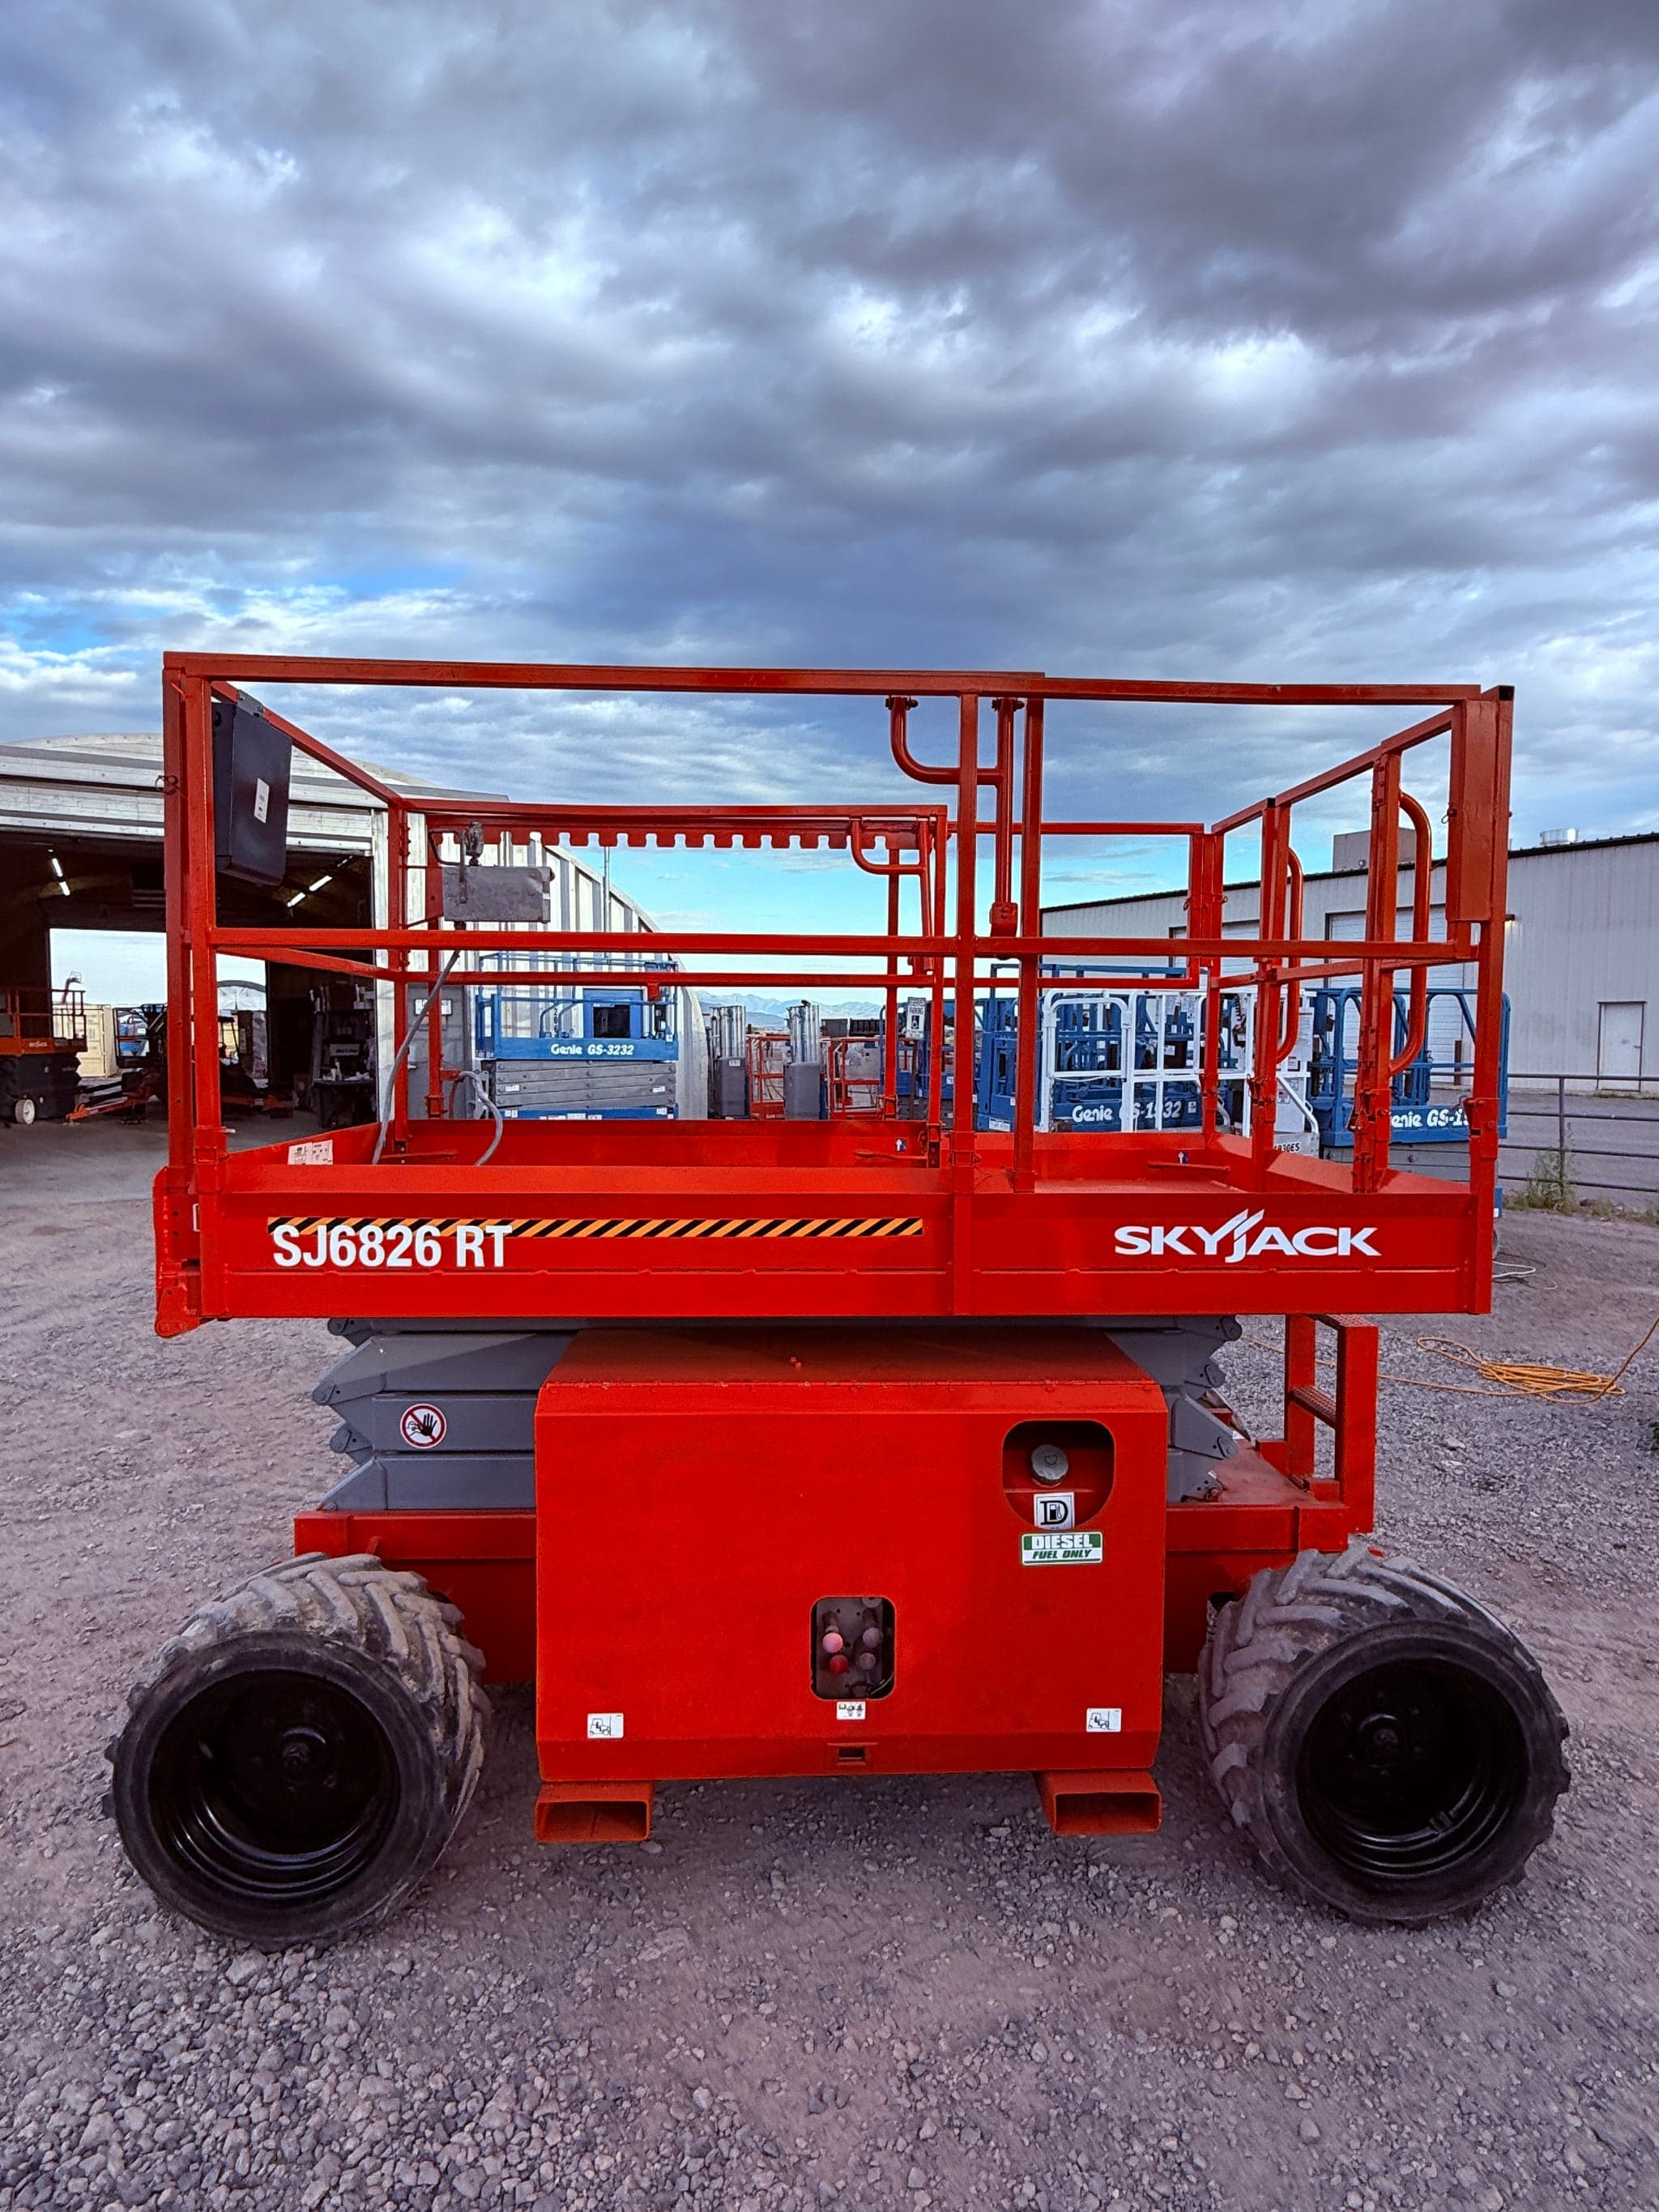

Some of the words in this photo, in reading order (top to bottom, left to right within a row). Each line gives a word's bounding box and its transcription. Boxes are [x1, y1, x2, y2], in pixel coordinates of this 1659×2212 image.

[550, 1043, 582, 1055] Genie
[587, 1044, 634, 1055] GS-3232
[1073, 1105, 1113, 1123] Genie
[1120, 1101, 1182, 1119] S-132
[1389, 1110, 1423, 1127] enie
[1115, 1208, 1382, 1264] SKYJACK
[273, 1225, 441, 1267] SJ6826
[456, 1225, 513, 1268] RT
[1031, 1534, 1093, 1549] DIESEL
[1032, 1550, 1058, 1560] FUEL
[1062, 1549, 1092, 1559] ONLY
